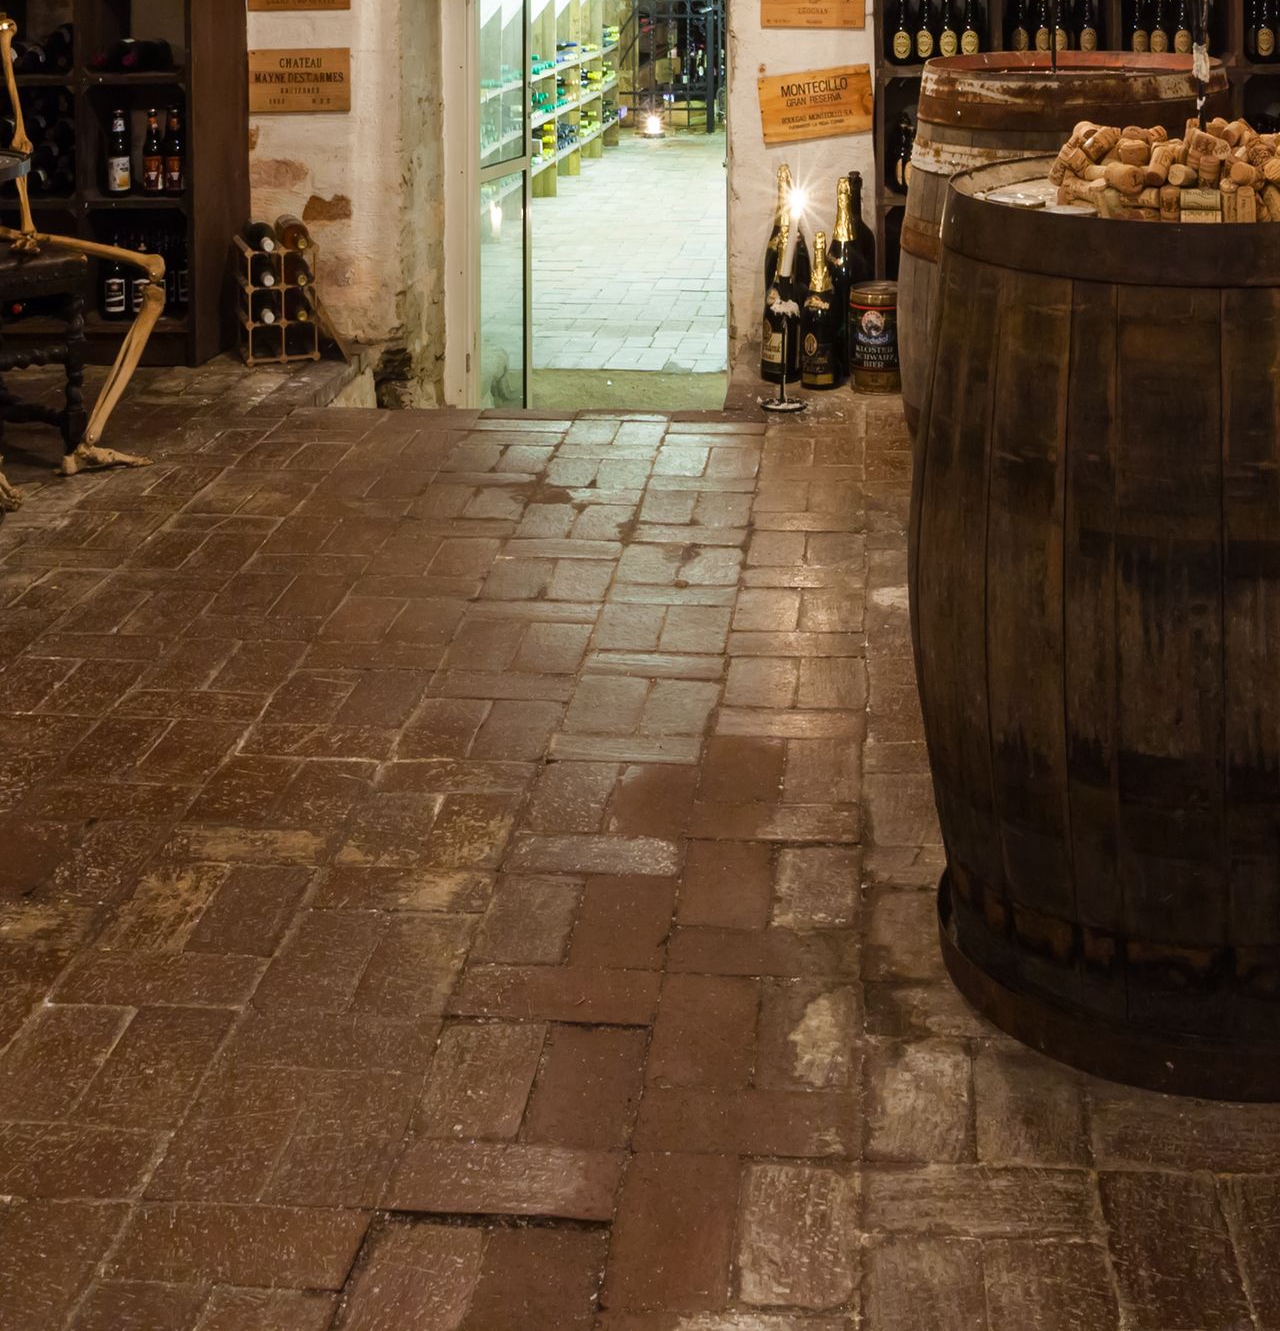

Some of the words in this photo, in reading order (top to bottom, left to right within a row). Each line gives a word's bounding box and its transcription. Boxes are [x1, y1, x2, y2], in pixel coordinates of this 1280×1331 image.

[279, 57, 322, 69] CHATEAU
[254, 72, 287, 84] MAYNE
[287, 71, 306, 84] DES
[781, 77, 849, 98] MONTECILLO
[786, 97, 807, 108] GRAN
[809, 92, 843, 105] RESERVA
[855, 344, 894, 354] KLOSTER
[863, 360, 885, 369] BIER
